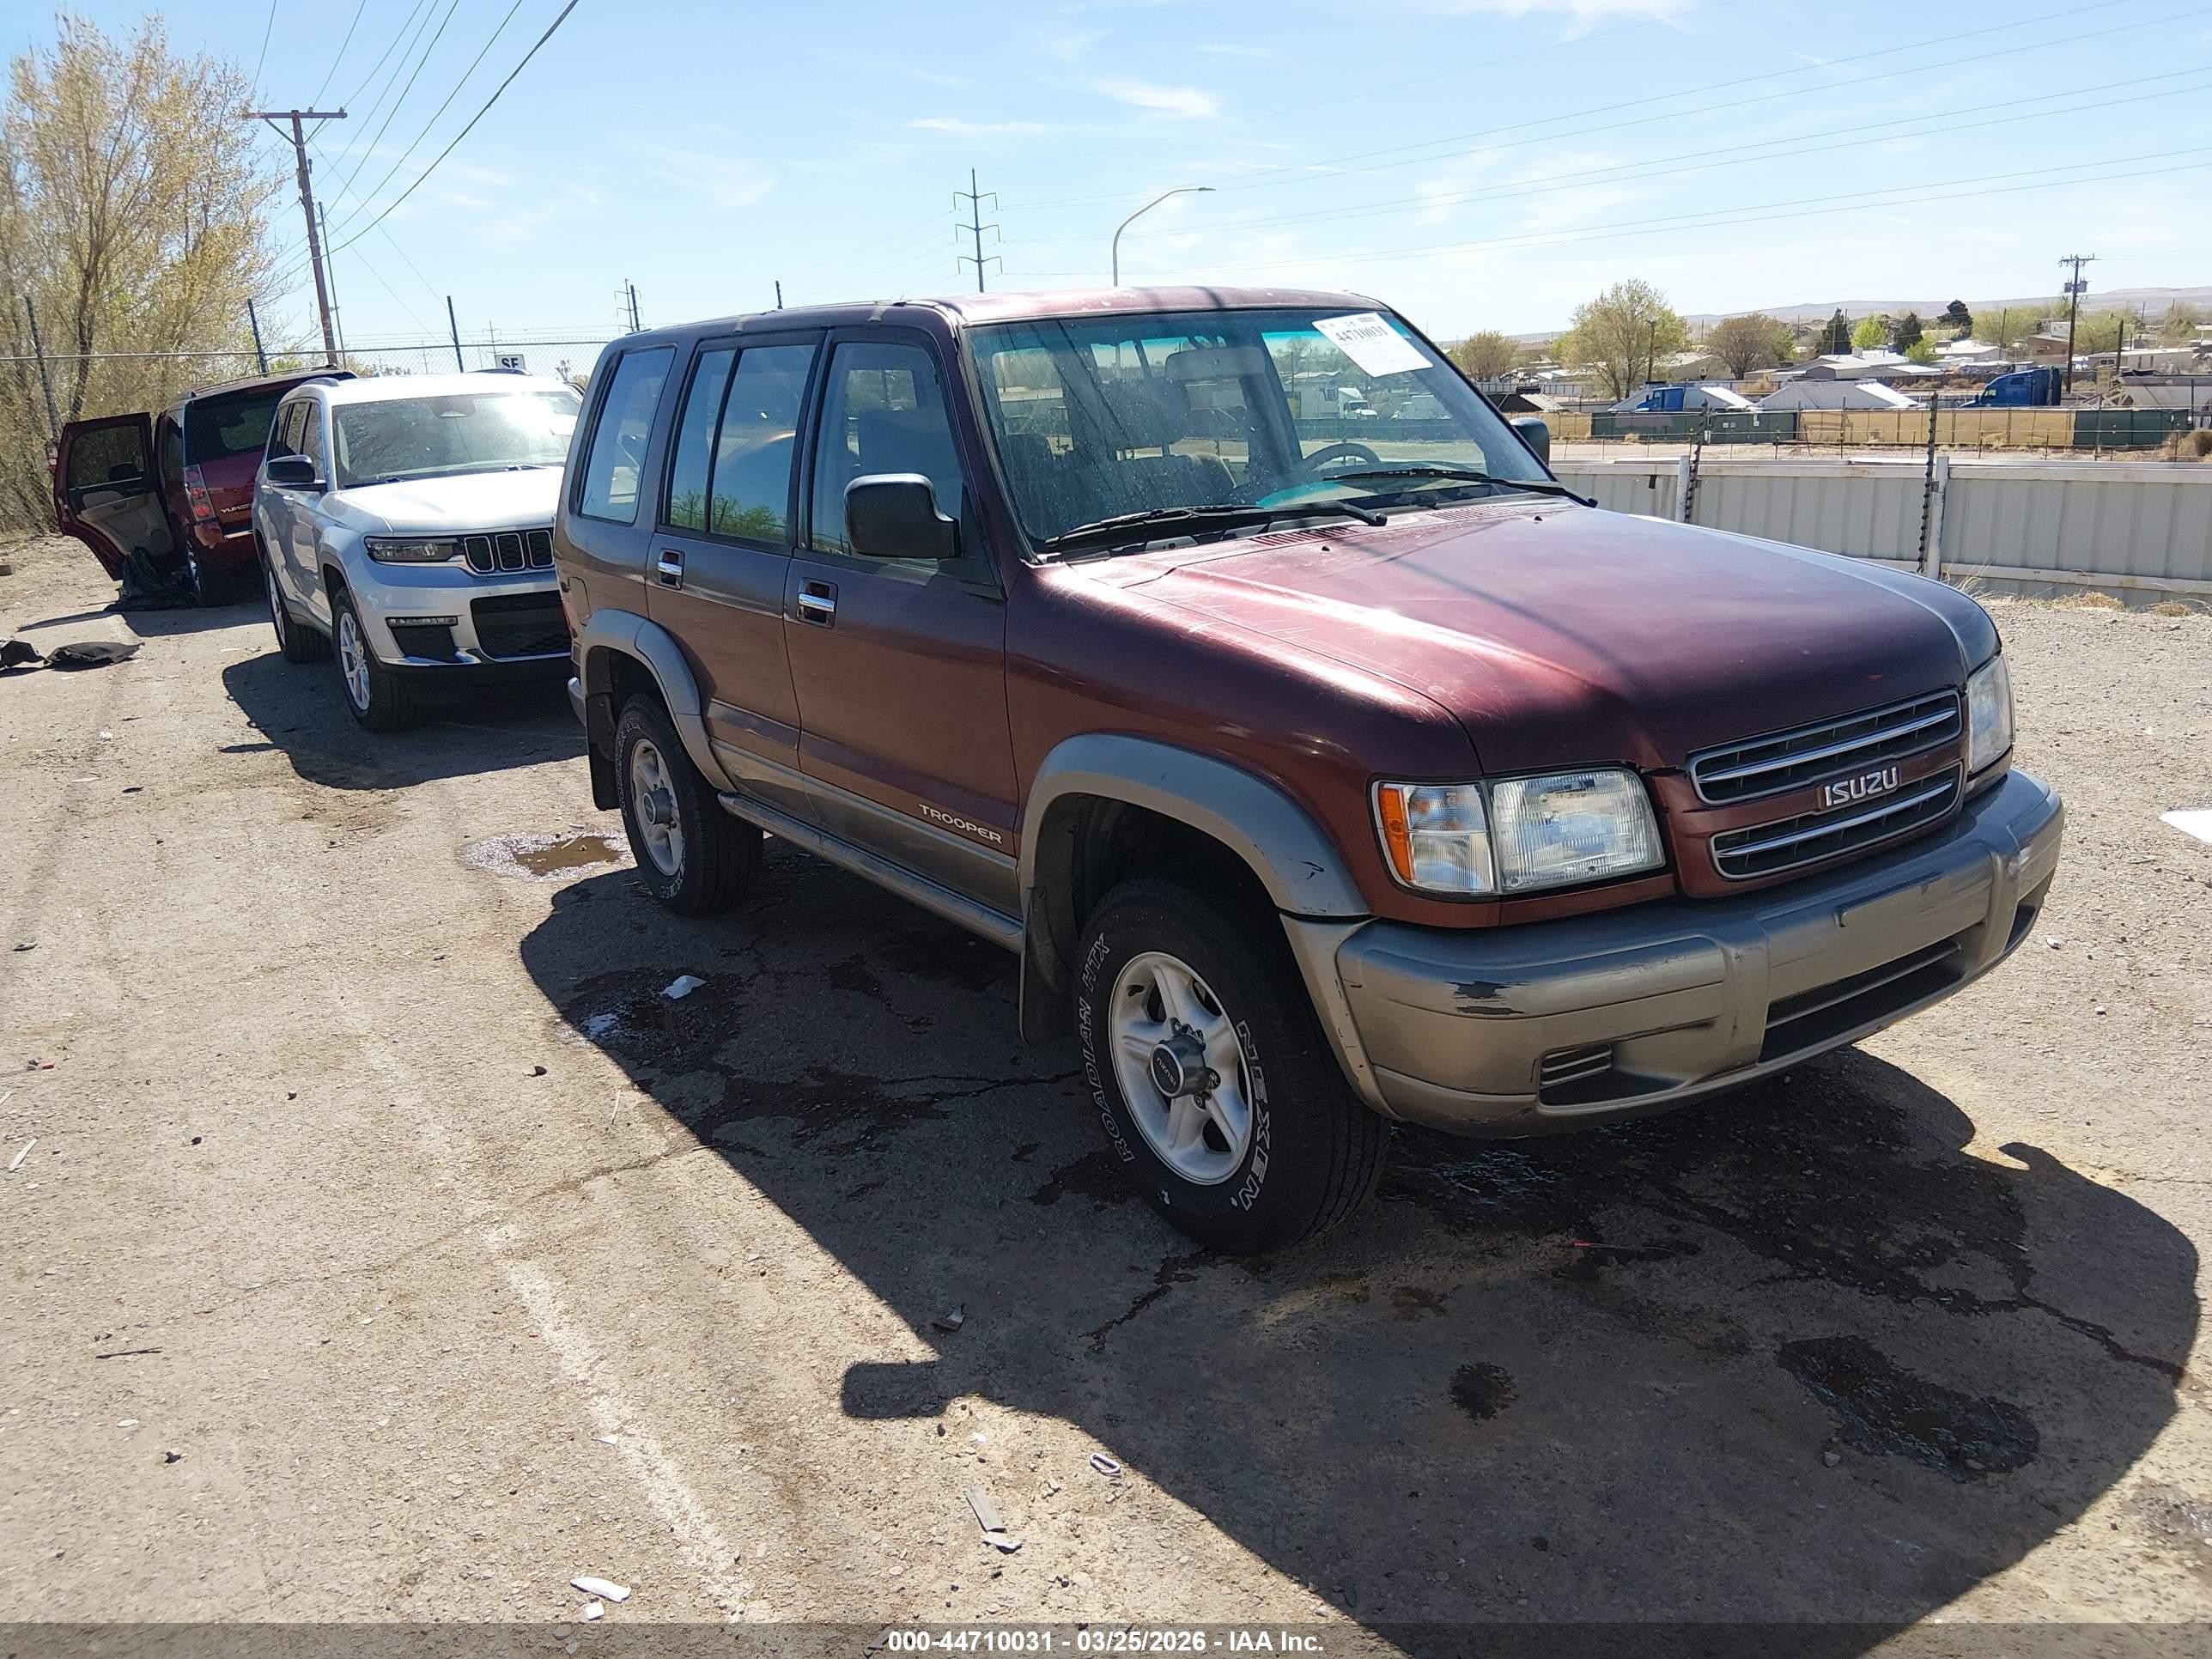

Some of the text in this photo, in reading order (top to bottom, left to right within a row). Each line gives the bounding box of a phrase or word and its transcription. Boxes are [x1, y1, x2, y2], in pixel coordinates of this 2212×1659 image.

[1824, 766, 1898, 807] ISUZU
[919, 804, 1003, 844] TROOPER
[1079, 933, 1135, 1162] ROADIAN HTX
[1157, 1057, 1176, 1086] ISUZU
[1237, 1019, 1270, 1211] NEXEN
